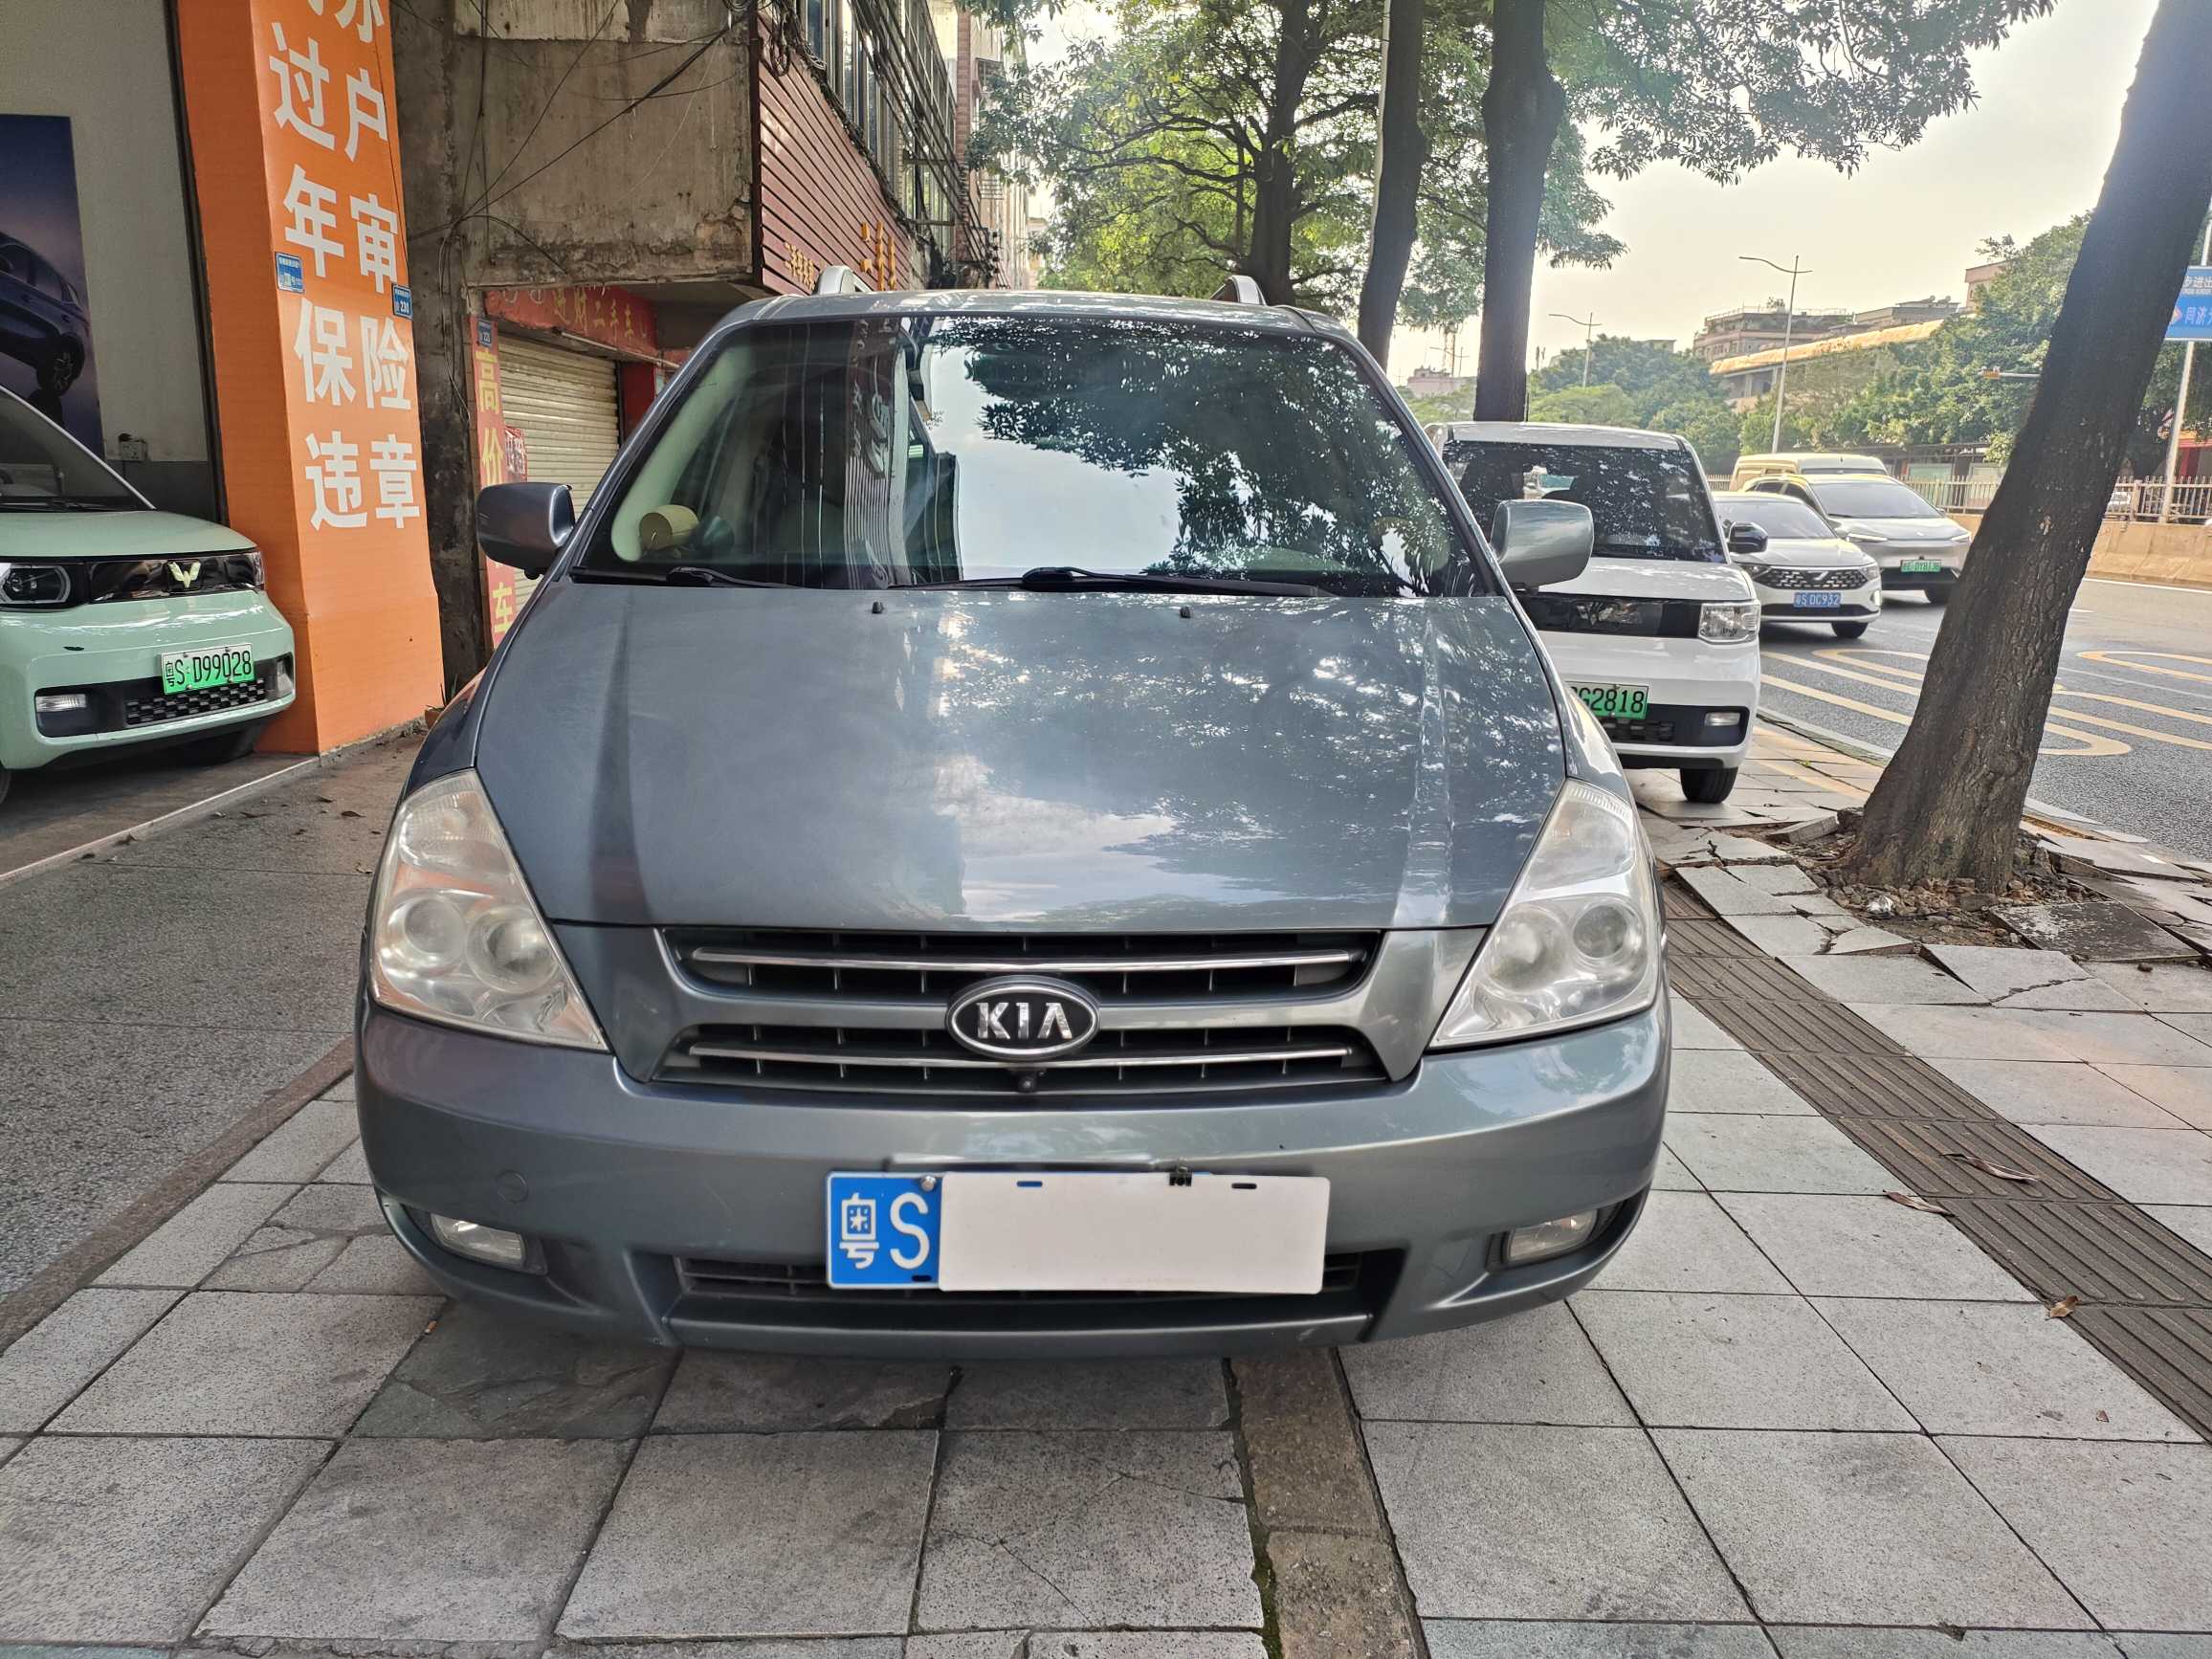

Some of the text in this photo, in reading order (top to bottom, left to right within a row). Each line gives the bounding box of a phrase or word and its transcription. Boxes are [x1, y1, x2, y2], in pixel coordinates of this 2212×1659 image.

[266, 22, 387, 162] 过户
[283, 164, 398, 294] 年审
[293, 297, 411, 409] 保险
[305, 431, 421, 530] 违章
[476, 347, 512, 633] 高价车
[1570, 686, 1645, 714] G2818
[977, 1002, 1073, 1040] KIA
[838, 1191, 931, 1270] 粤S
